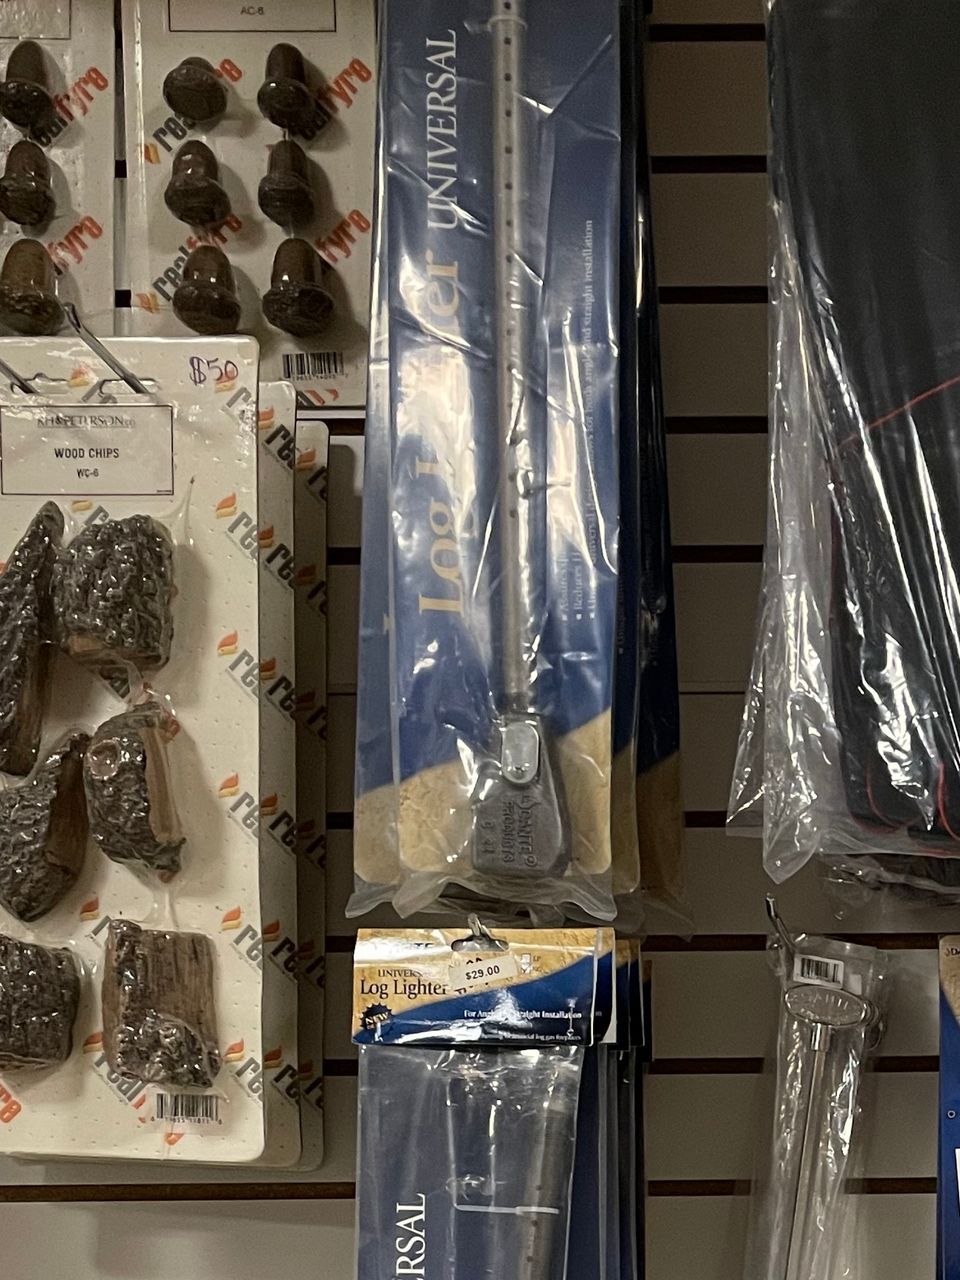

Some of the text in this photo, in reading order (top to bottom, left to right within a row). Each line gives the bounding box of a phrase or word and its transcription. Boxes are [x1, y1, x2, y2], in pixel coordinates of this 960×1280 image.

[426, 29, 457, 230] UNIVERSAL
[189, 356, 239, 386] $50
[54, 447, 120, 459] WOOD CHIPS
[465, 964, 501, 980] $29.00
[360, 979, 448, 998] Log Lighter
[365, 1012, 390, 1026] NEW
[464, 1010, 477, 1018] For
